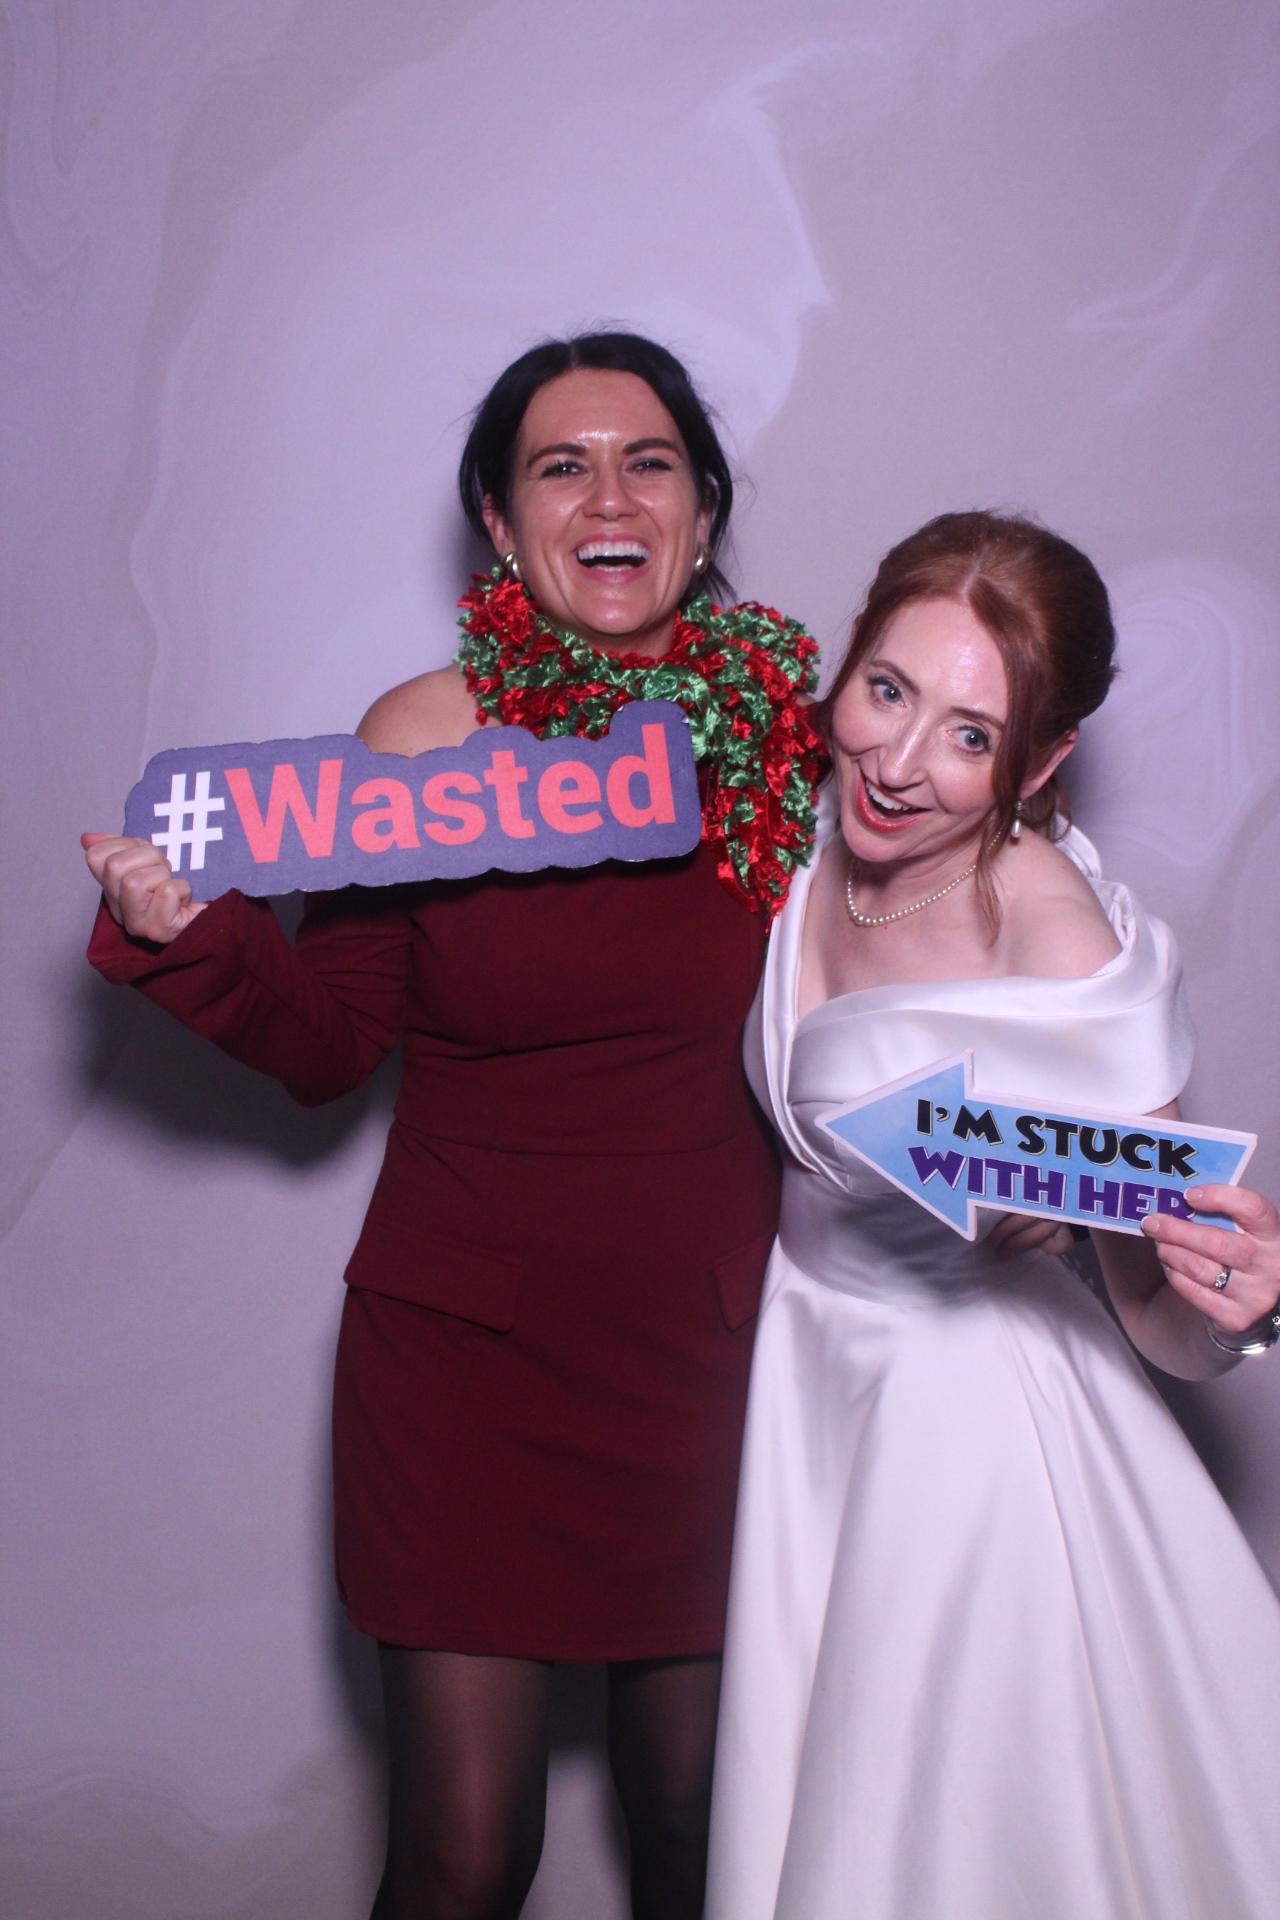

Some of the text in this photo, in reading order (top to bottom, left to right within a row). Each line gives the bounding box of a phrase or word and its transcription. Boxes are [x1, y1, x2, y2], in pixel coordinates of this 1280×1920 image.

[151, 723, 677, 873] #Wasted
[915, 1098, 1199, 1180] I'M STUCK
[907, 1145, 1196, 1223] WITH HER
